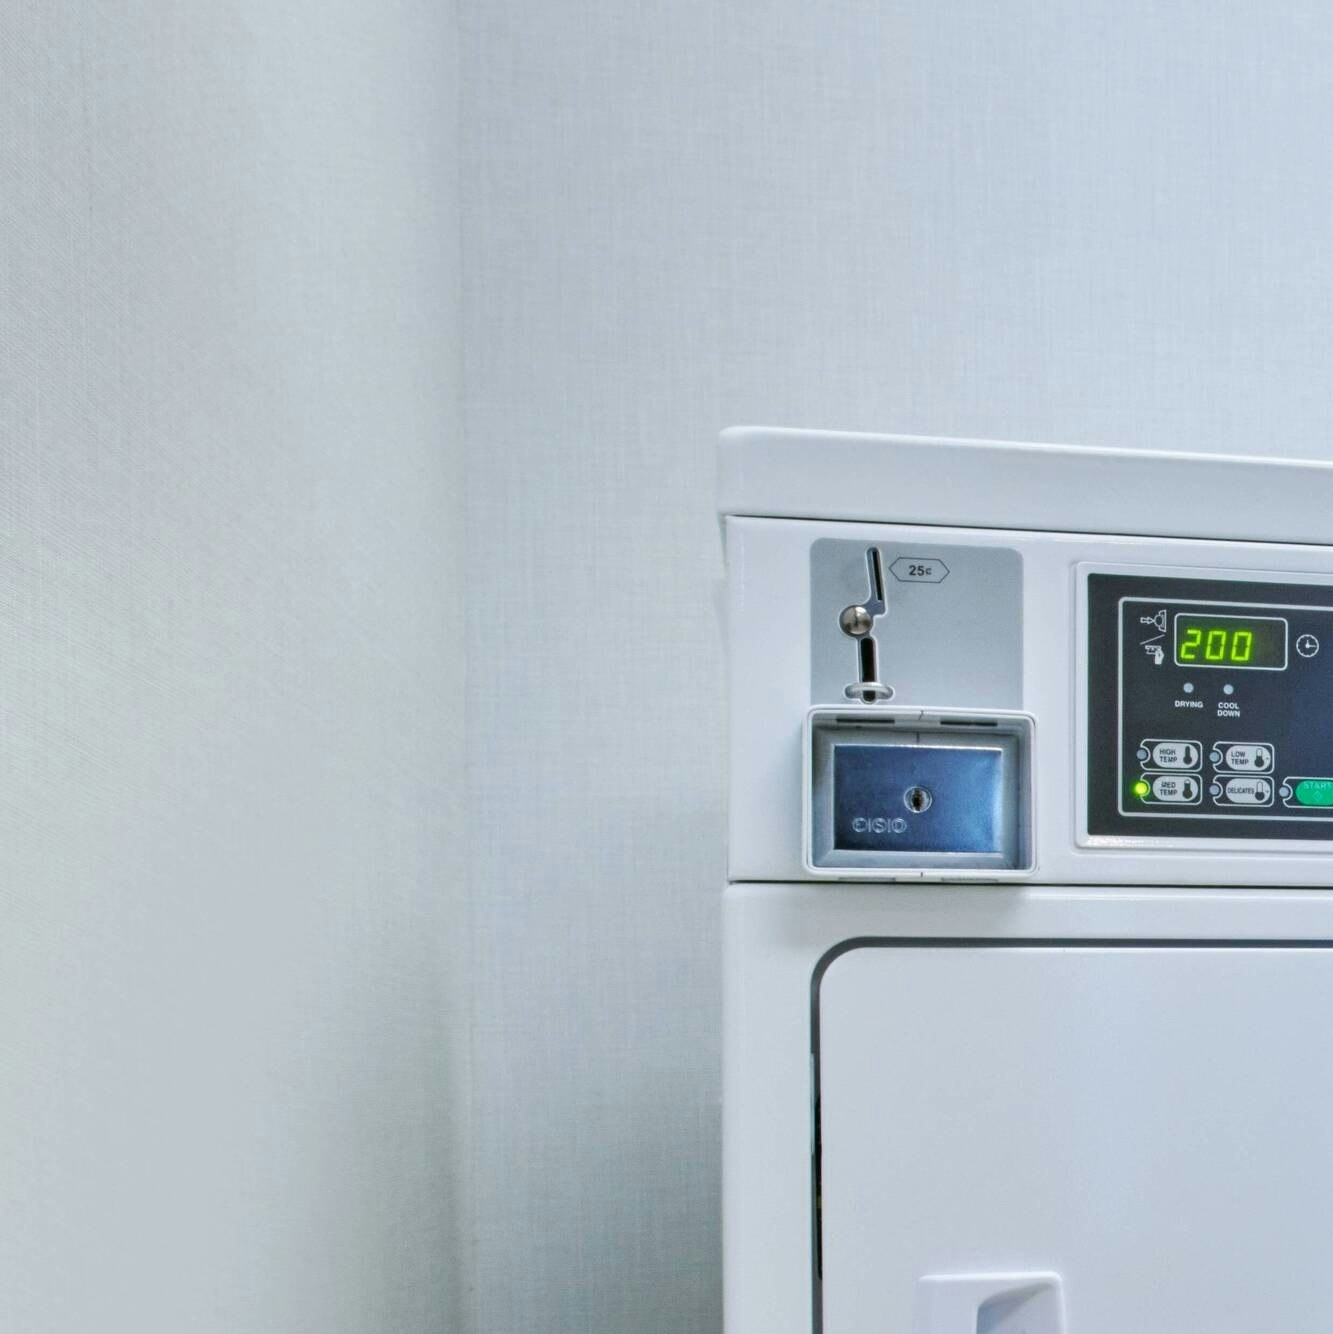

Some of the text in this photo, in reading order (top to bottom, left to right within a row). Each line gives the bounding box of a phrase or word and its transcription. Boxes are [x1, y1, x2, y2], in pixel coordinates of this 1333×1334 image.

[1180, 629, 1252, 661] 200
[1231, 758, 1249, 766] TEMP
[1303, 782, 1331, 790] START
